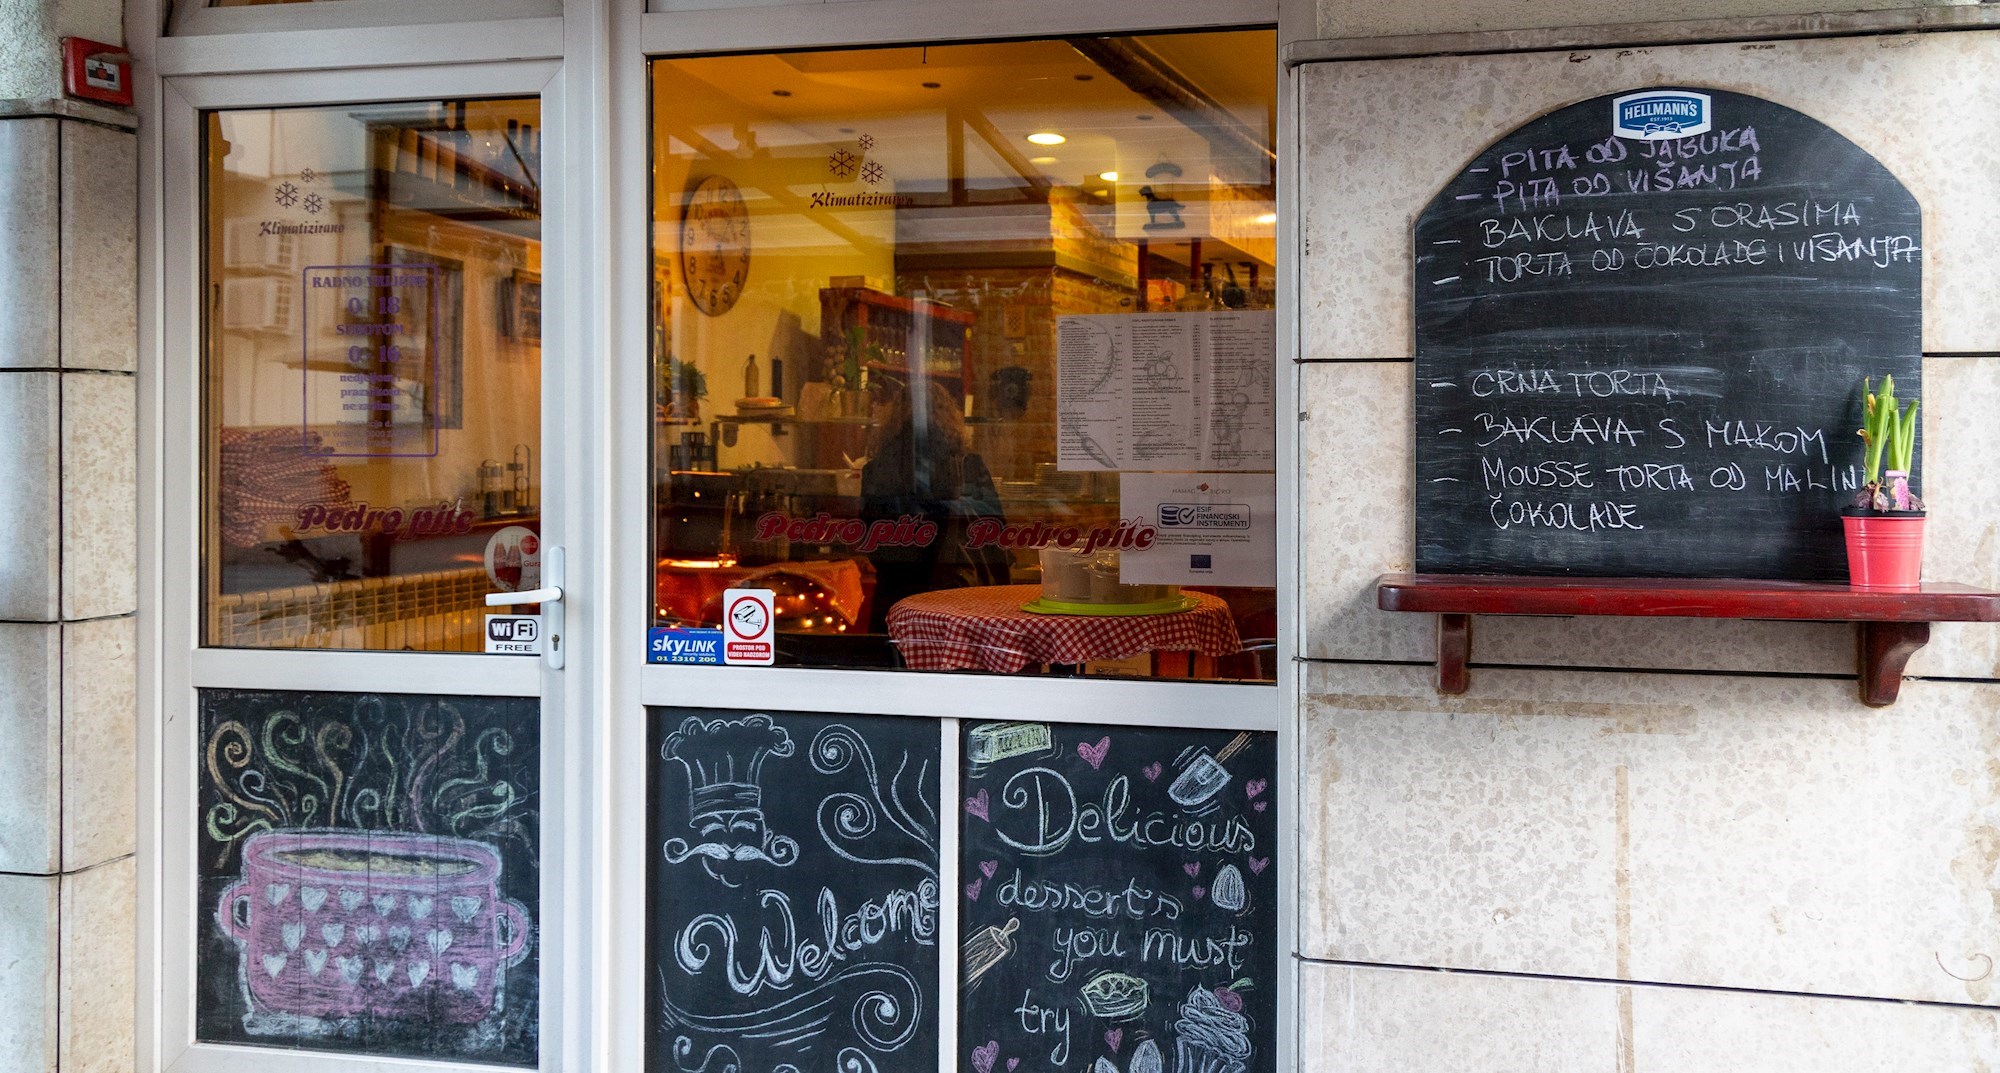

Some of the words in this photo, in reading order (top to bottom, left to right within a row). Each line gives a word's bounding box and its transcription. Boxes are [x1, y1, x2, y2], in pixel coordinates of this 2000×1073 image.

[1624, 101, 1698, 121] HELLMANN'S
[1502, 144, 1579, 178] PITA
[1586, 136, 1628, 164] OD
[1640, 126, 1761, 159] JABUKA
[810, 191, 914, 209] Klimatizirano
[1493, 177, 1560, 214] PITA
[1573, 173, 1611, 196] OD
[1627, 154, 1762, 194] VIŠANJA
[258, 220, 345, 237] Klimatizirano
[1480, 209, 1645, 248] BAKLAVA
[1672, 208, 1702, 232] S
[1711, 200, 1861, 231] ORASIMA
[1475, 252, 1572, 283] TORTA
[1592, 249, 1625, 271] OD
[1635, 239, 1766, 269] ČOKOLADE
[1793, 232, 1922, 269] VIŠANJA
[1472, 369, 1562, 397] CRNA
[1568, 370, 1678, 400] TORTA
[1474, 412, 1645, 447] BAKLAVA
[1659, 418, 1685, 449] S
[1706, 420, 1829, 464] MAKOM
[1482, 456, 1594, 491] MOUSSE
[1606, 464, 1695, 492] TORTA
[1709, 462, 1746, 491] OD
[1765, 464, 1868, 492] MALIN
[293, 501, 404, 534] Pedro
[401, 498, 480, 540] pite
[754, 511, 867, 544] Pedro
[858, 513, 939, 552] pite
[1196, 513, 1240, 521] FINANCIJSKI
[1490, 492, 1644, 532] ČOKOLADE
[966, 517, 1081, 550] Pedro
[1075, 516, 1159, 558] pite
[996, 766, 1256, 855] Delicious
[997, 868, 1184, 920] desserts
[676, 876, 940, 996] Welcome
[1050, 927, 1126, 981] you
[1144, 926, 1253, 972] must
[1014, 988, 1071, 1067] try
